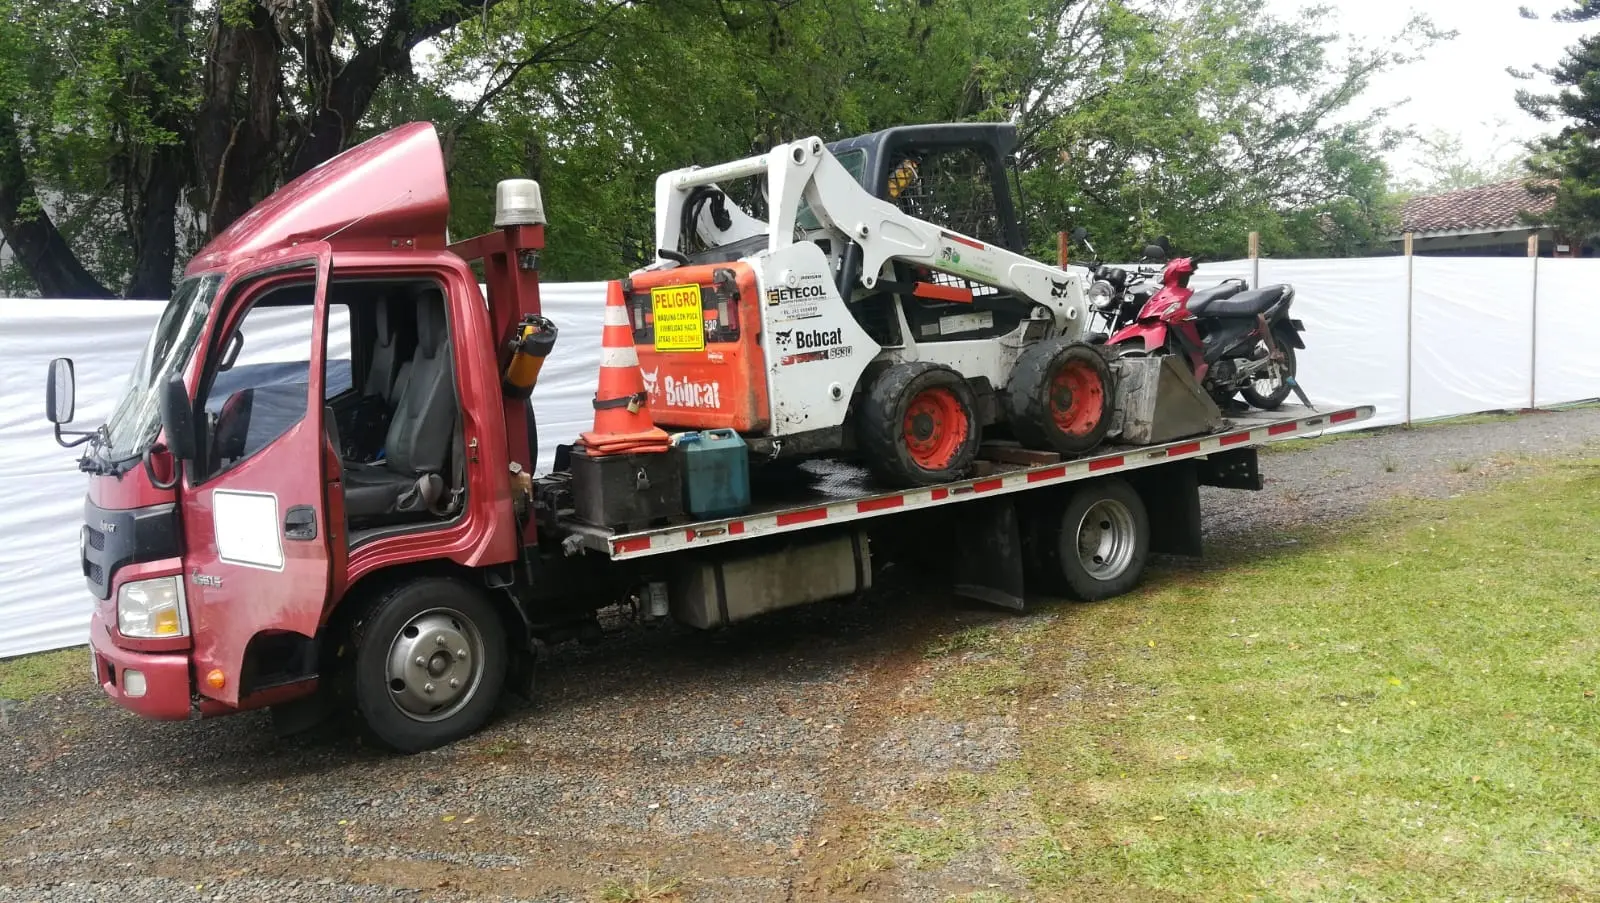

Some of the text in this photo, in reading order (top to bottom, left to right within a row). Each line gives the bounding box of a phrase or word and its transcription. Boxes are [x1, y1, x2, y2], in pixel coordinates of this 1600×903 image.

[655, 291, 697, 309] PELIGRO
[780, 285, 826, 301] ETECOL
[795, 327, 843, 349] Bobcat
[664, 375, 720, 409] Bobcat
